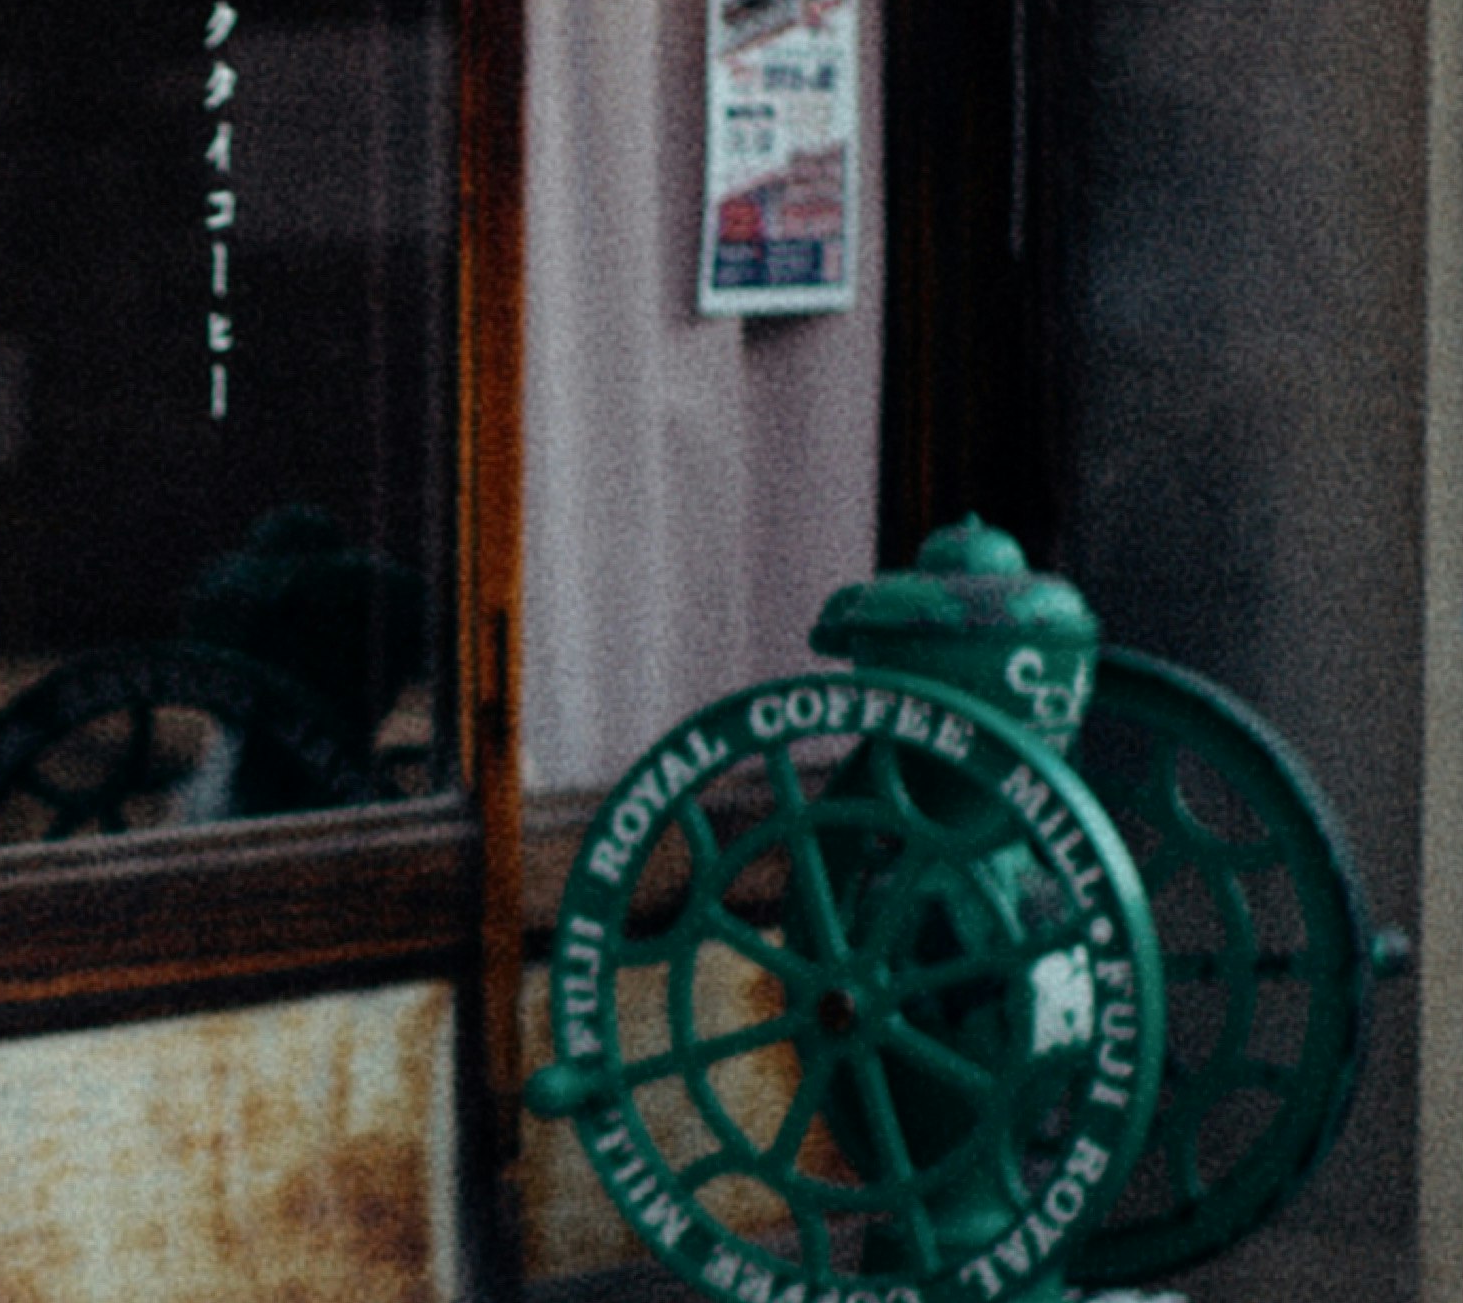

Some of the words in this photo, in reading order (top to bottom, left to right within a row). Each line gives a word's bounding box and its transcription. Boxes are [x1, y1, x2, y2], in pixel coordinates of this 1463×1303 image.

[563, 915, 604, 1056] FUJI
[589, 730, 728, 884] ROYAL
[749, 686, 974, 759] COFFEE
[1001, 764, 1103, 909] MILL
[1090, 959, 1137, 1108] FUJI
[595, 1110, 691, 1247] MILL
[959, 1137, 1110, 1300] ROYAL
